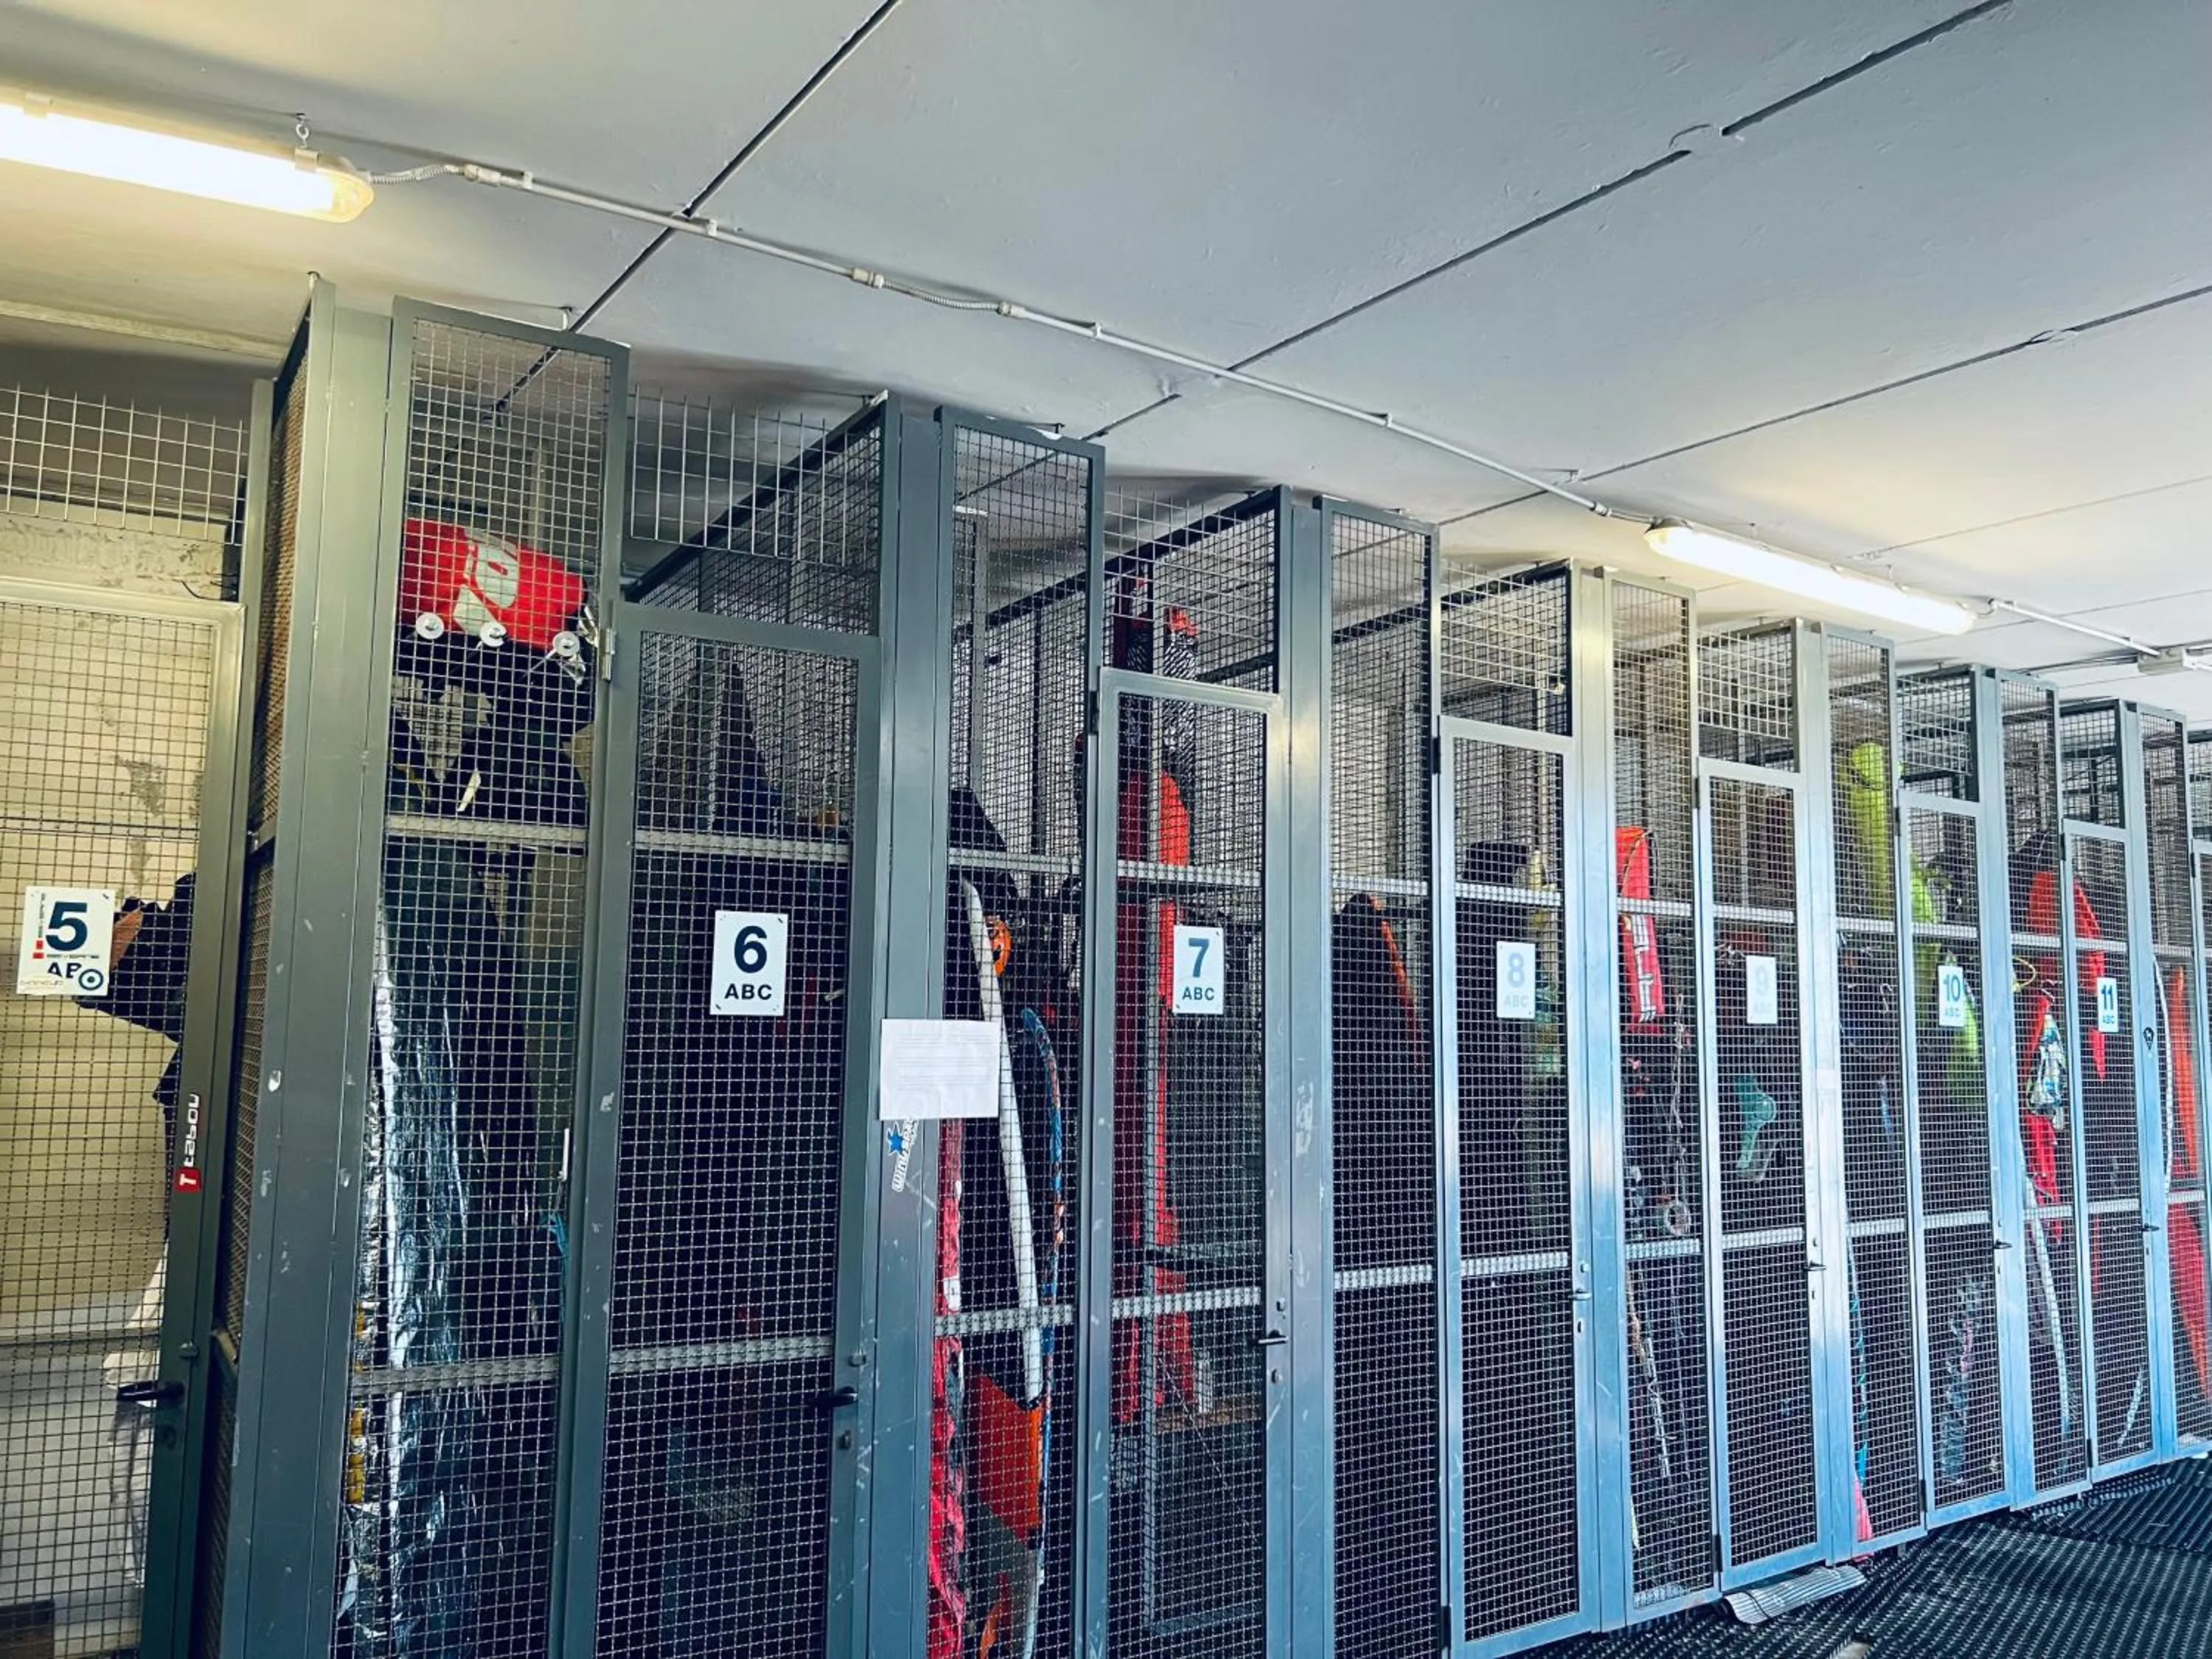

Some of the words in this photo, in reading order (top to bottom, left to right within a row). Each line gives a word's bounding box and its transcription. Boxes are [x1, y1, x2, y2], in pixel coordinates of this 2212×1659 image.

[45, 901, 88, 951] 5
[734, 925, 768, 973] 6
[1189, 937, 1209, 978] 7
[1508, 952, 1524, 987] 8
[1755, 964, 1768, 996] 9
[724, 983, 772, 1000] ABC
[1182, 986, 1215, 1001] ABC
[1503, 995, 1529, 1008] ABC
[1943, 974, 1961, 1001] 10
[2101, 984, 2113, 1010] 11
[184, 1093, 200, 1167] tabou
